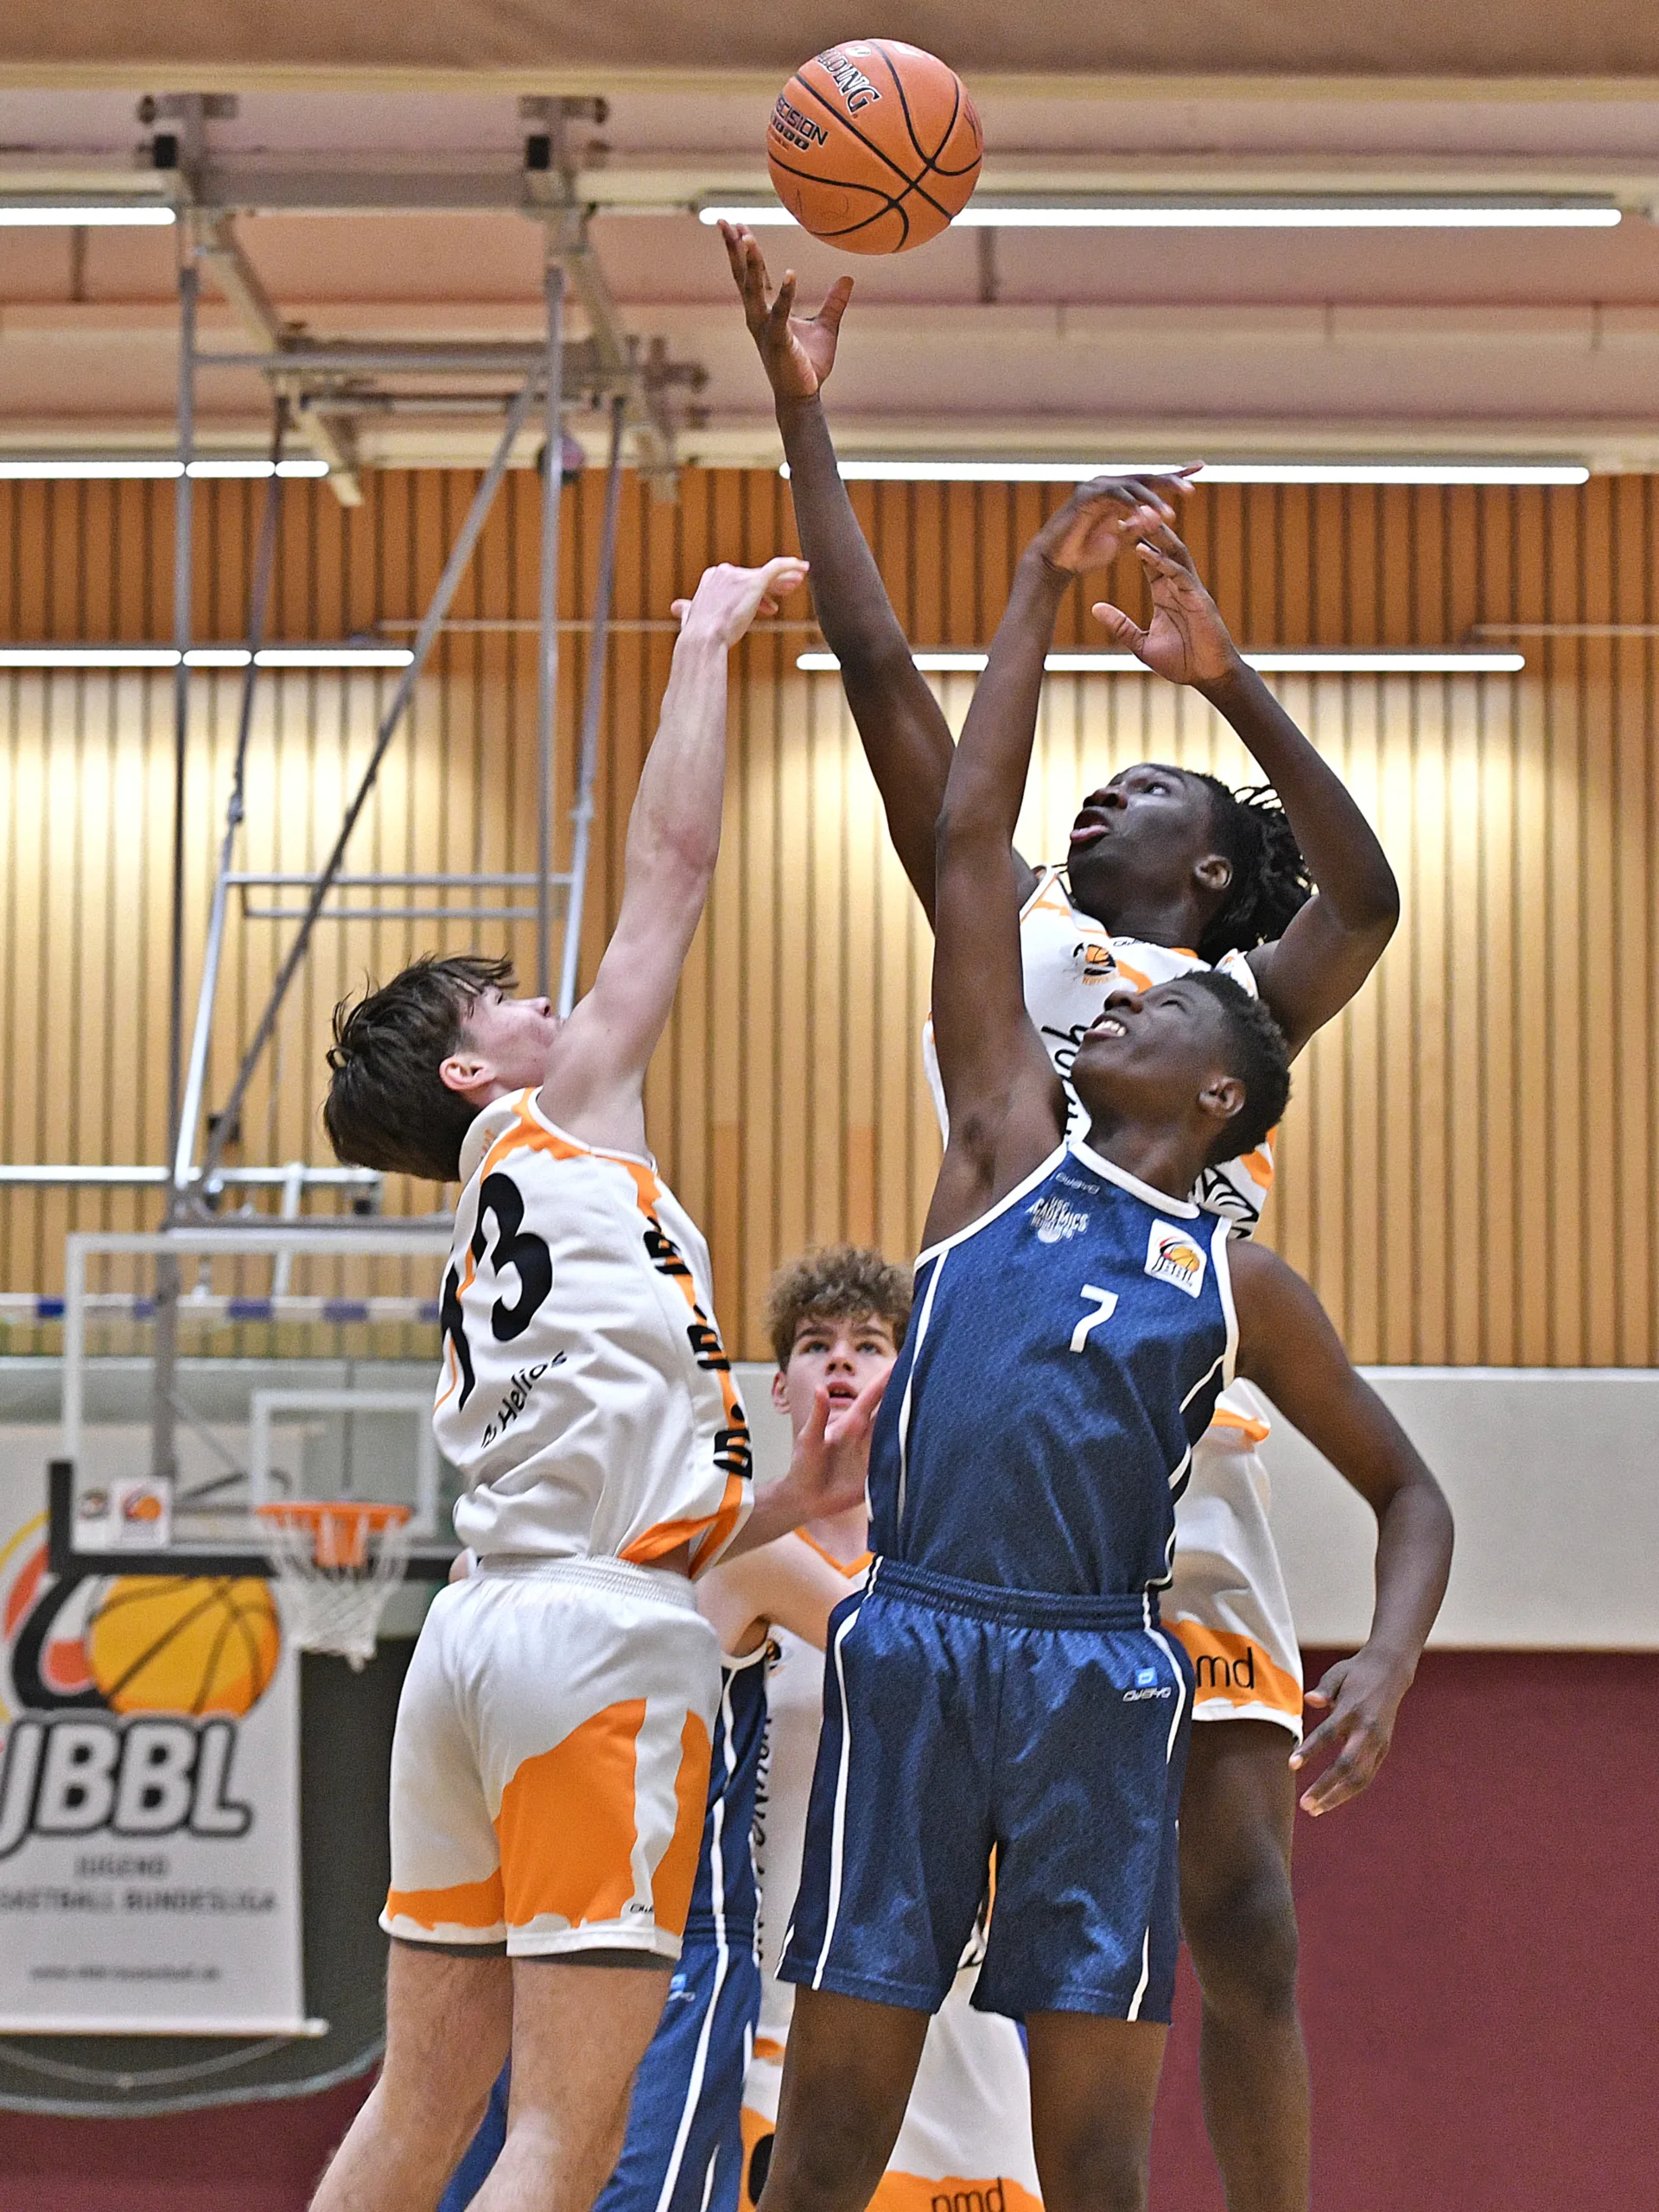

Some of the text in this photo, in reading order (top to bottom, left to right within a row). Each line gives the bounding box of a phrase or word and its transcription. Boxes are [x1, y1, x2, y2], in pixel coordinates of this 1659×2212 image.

[776, 93, 829, 148] ECISION
[1069, 1283, 1119, 1354] 7
[498, 1350, 568, 1433] Helios
[1197, 1646, 1255, 1689] md
[0, 1713, 252, 1857] JBBL
